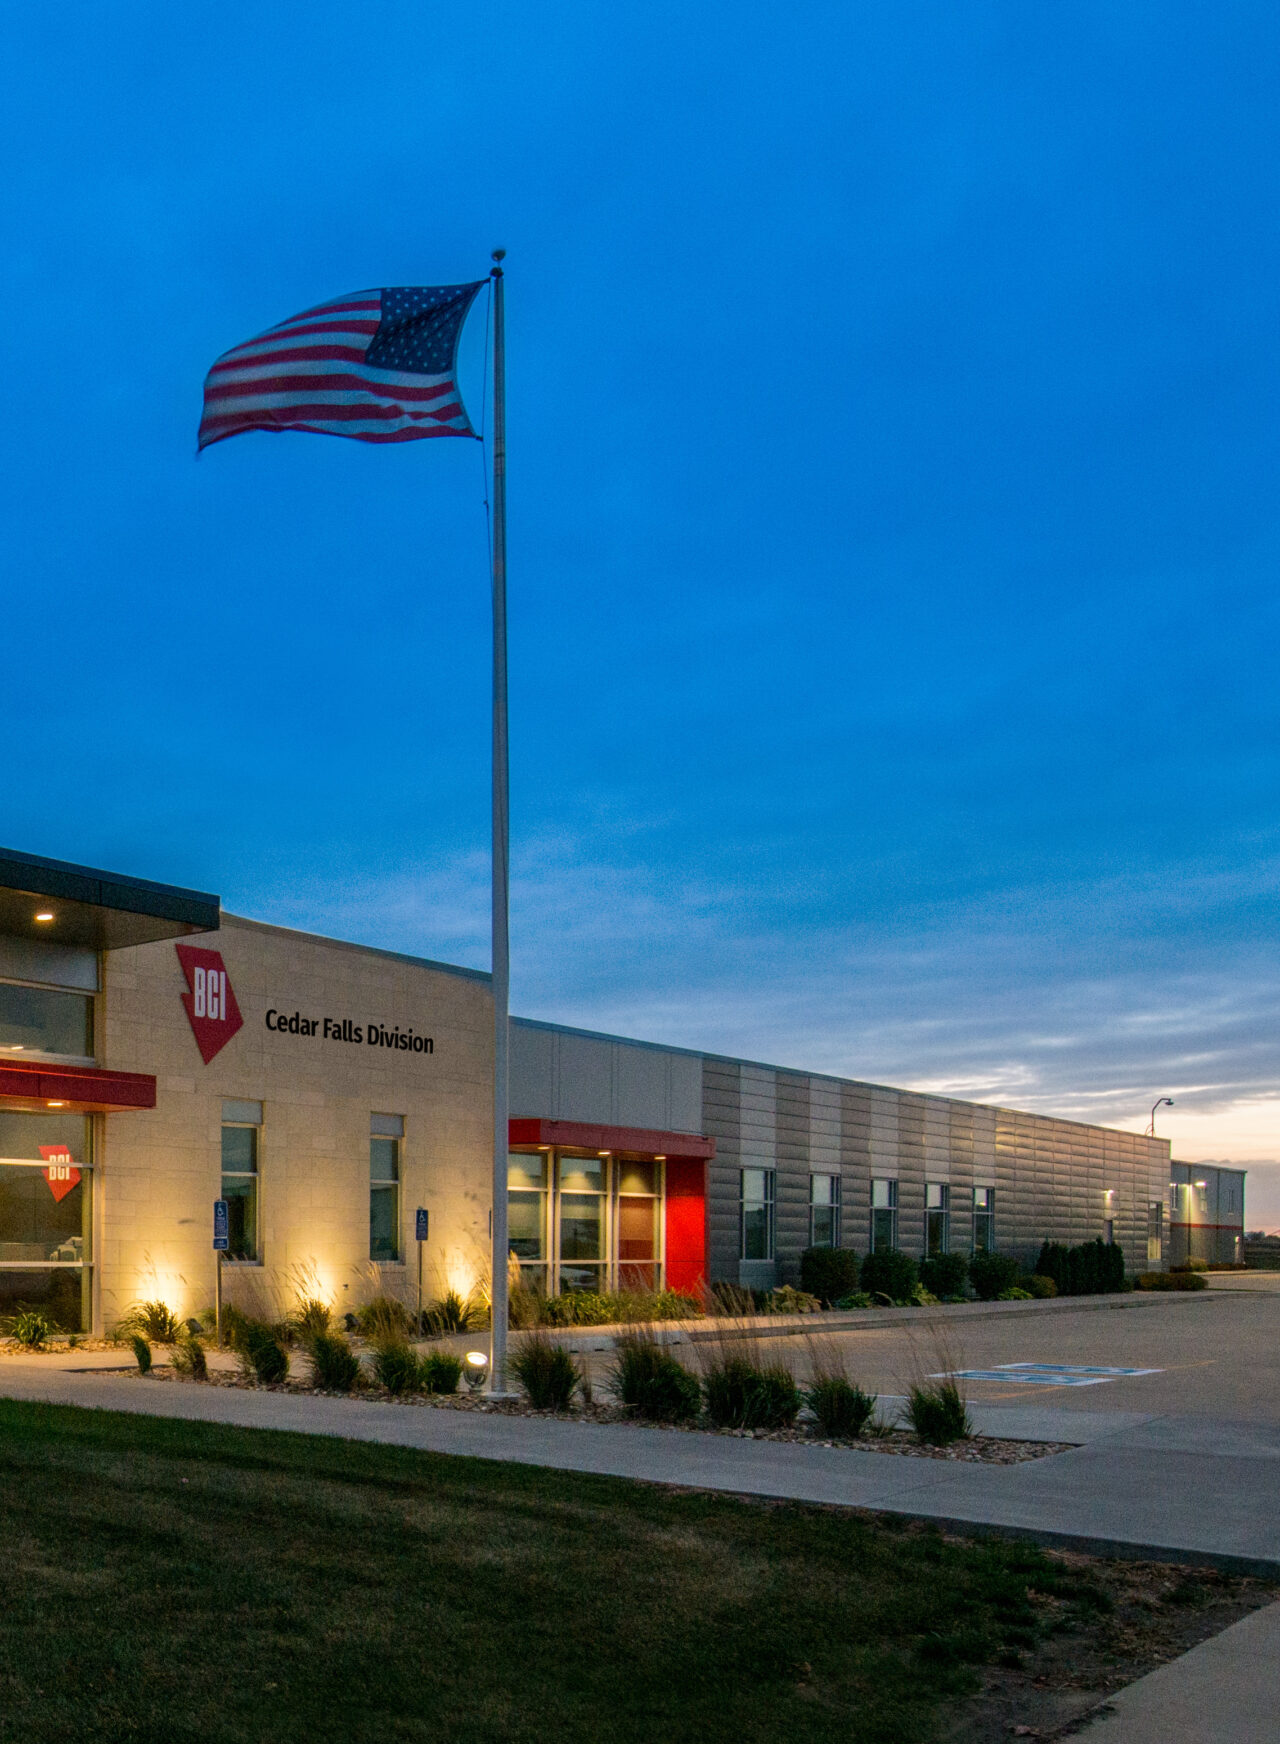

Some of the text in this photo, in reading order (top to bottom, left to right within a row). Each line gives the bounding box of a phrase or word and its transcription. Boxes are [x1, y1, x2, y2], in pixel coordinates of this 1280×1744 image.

[194, 966, 226, 1021] BCI
[265, 1009, 434, 1054] Cedar Falls Division
[49, 1154, 70, 1180] BCI
